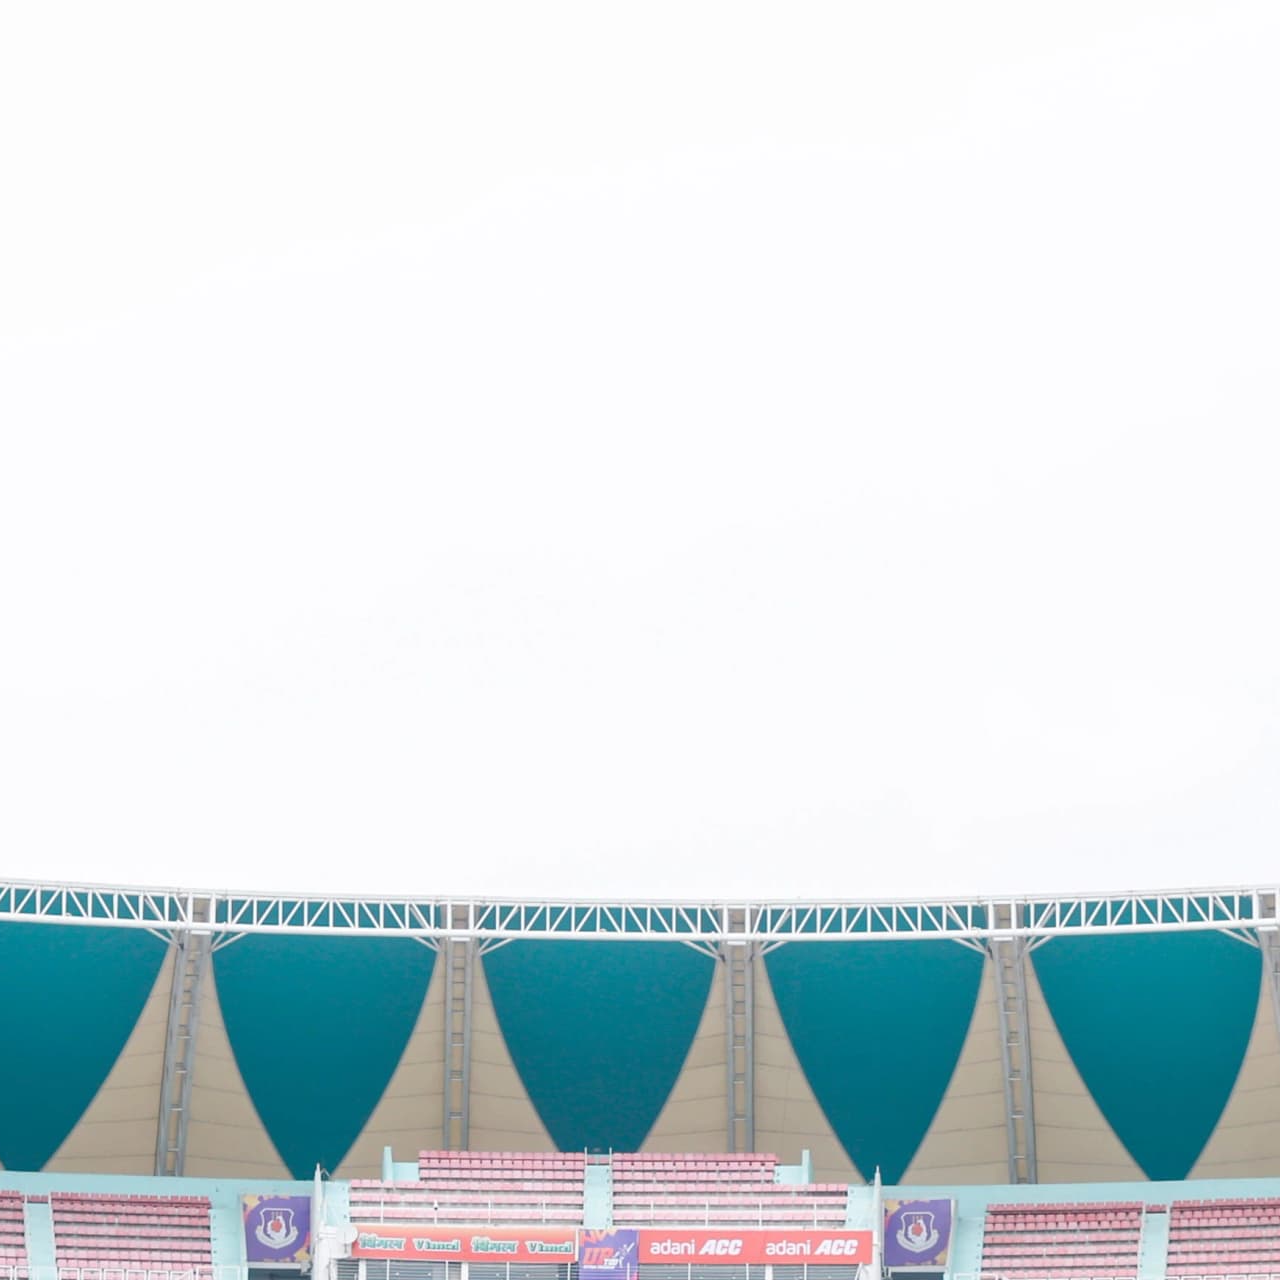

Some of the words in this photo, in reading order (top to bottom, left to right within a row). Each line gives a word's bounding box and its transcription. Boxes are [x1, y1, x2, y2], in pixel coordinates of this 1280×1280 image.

[650, 1240, 696, 1256] adani
[699, 1240, 742, 1256] ACC
[765, 1240, 811, 1256] adani
[815, 1240, 858, 1256] ACC
